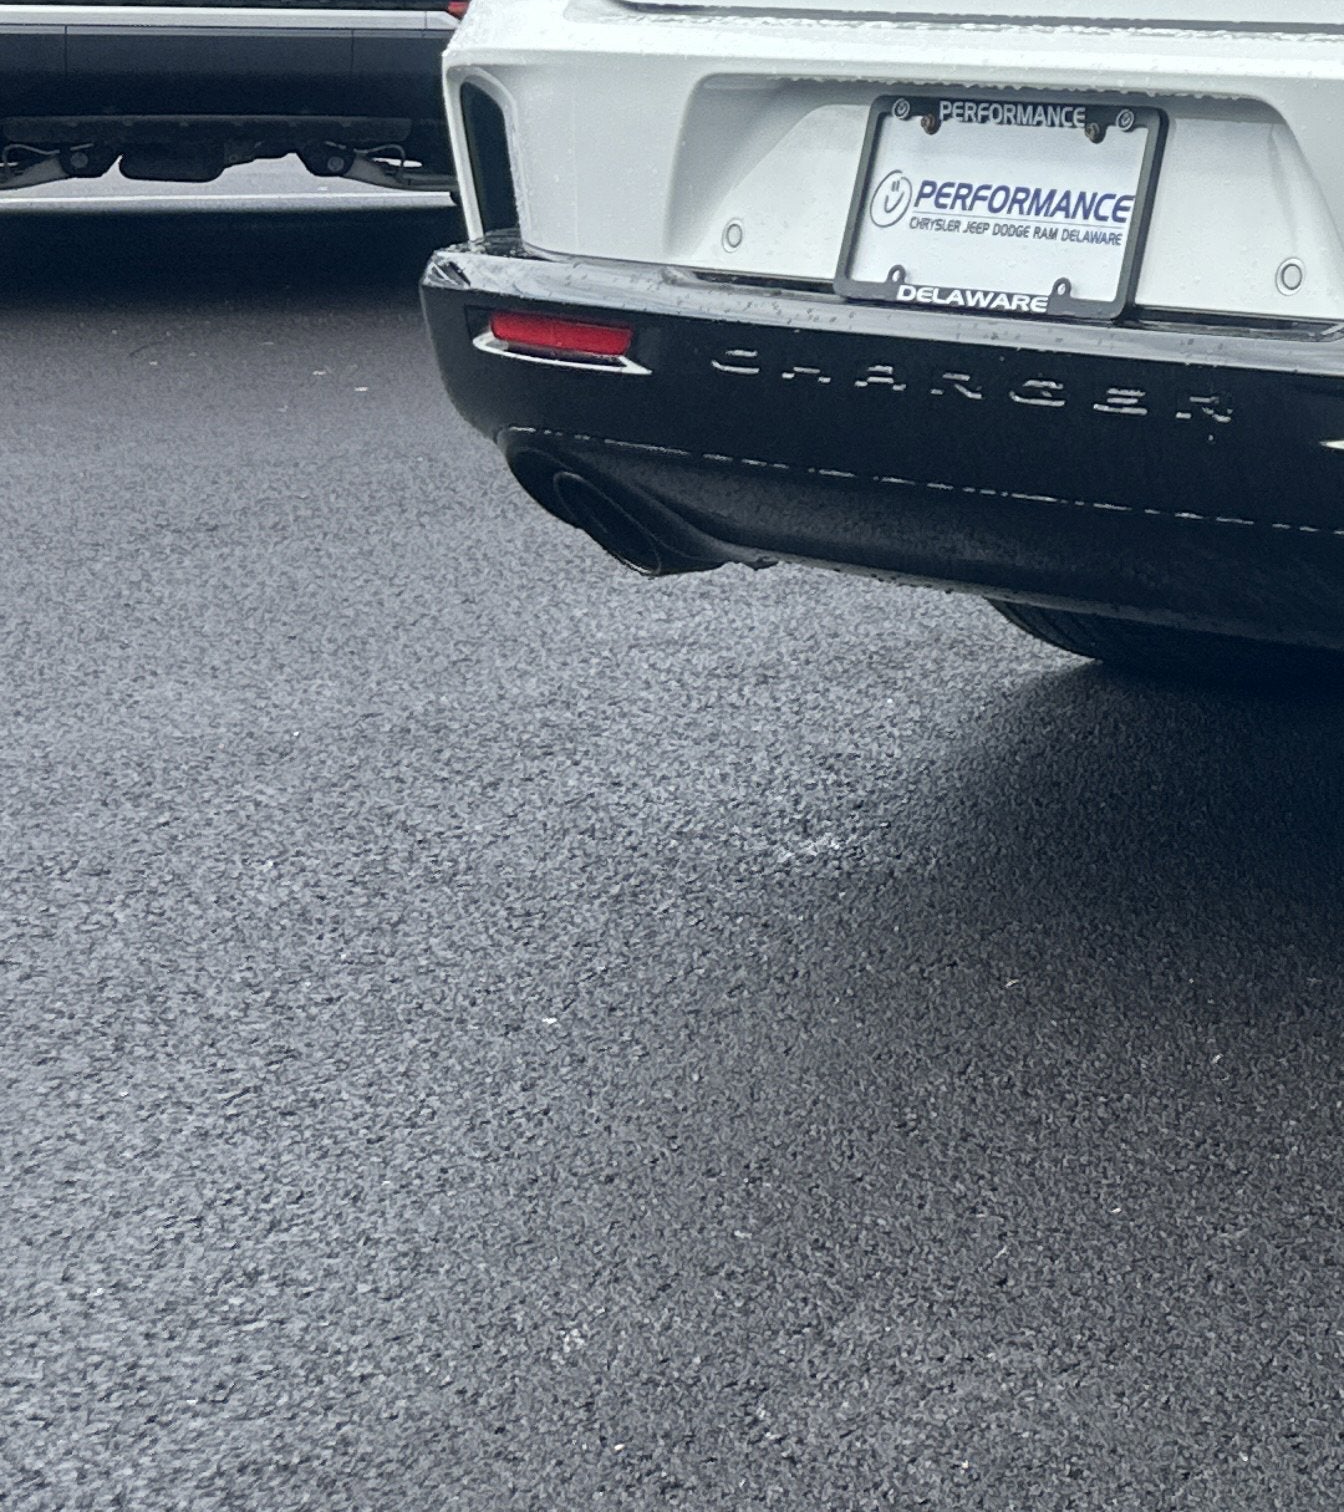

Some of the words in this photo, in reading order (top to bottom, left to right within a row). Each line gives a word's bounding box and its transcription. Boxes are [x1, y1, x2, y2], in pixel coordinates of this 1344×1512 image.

[939, 101, 1086, 129] PERFORMANCE
[914, 180, 1134, 223] PERFORMANCE
[909, 216, 961, 233] CHRYSLER
[962, 220, 990, 235] JEEP
[992, 222, 1031, 239] DODGE
[1032, 225, 1058, 240] RAM
[1061, 228, 1123, 246] DELAWARE
[896, 284, 1049, 313] DELAWARE
